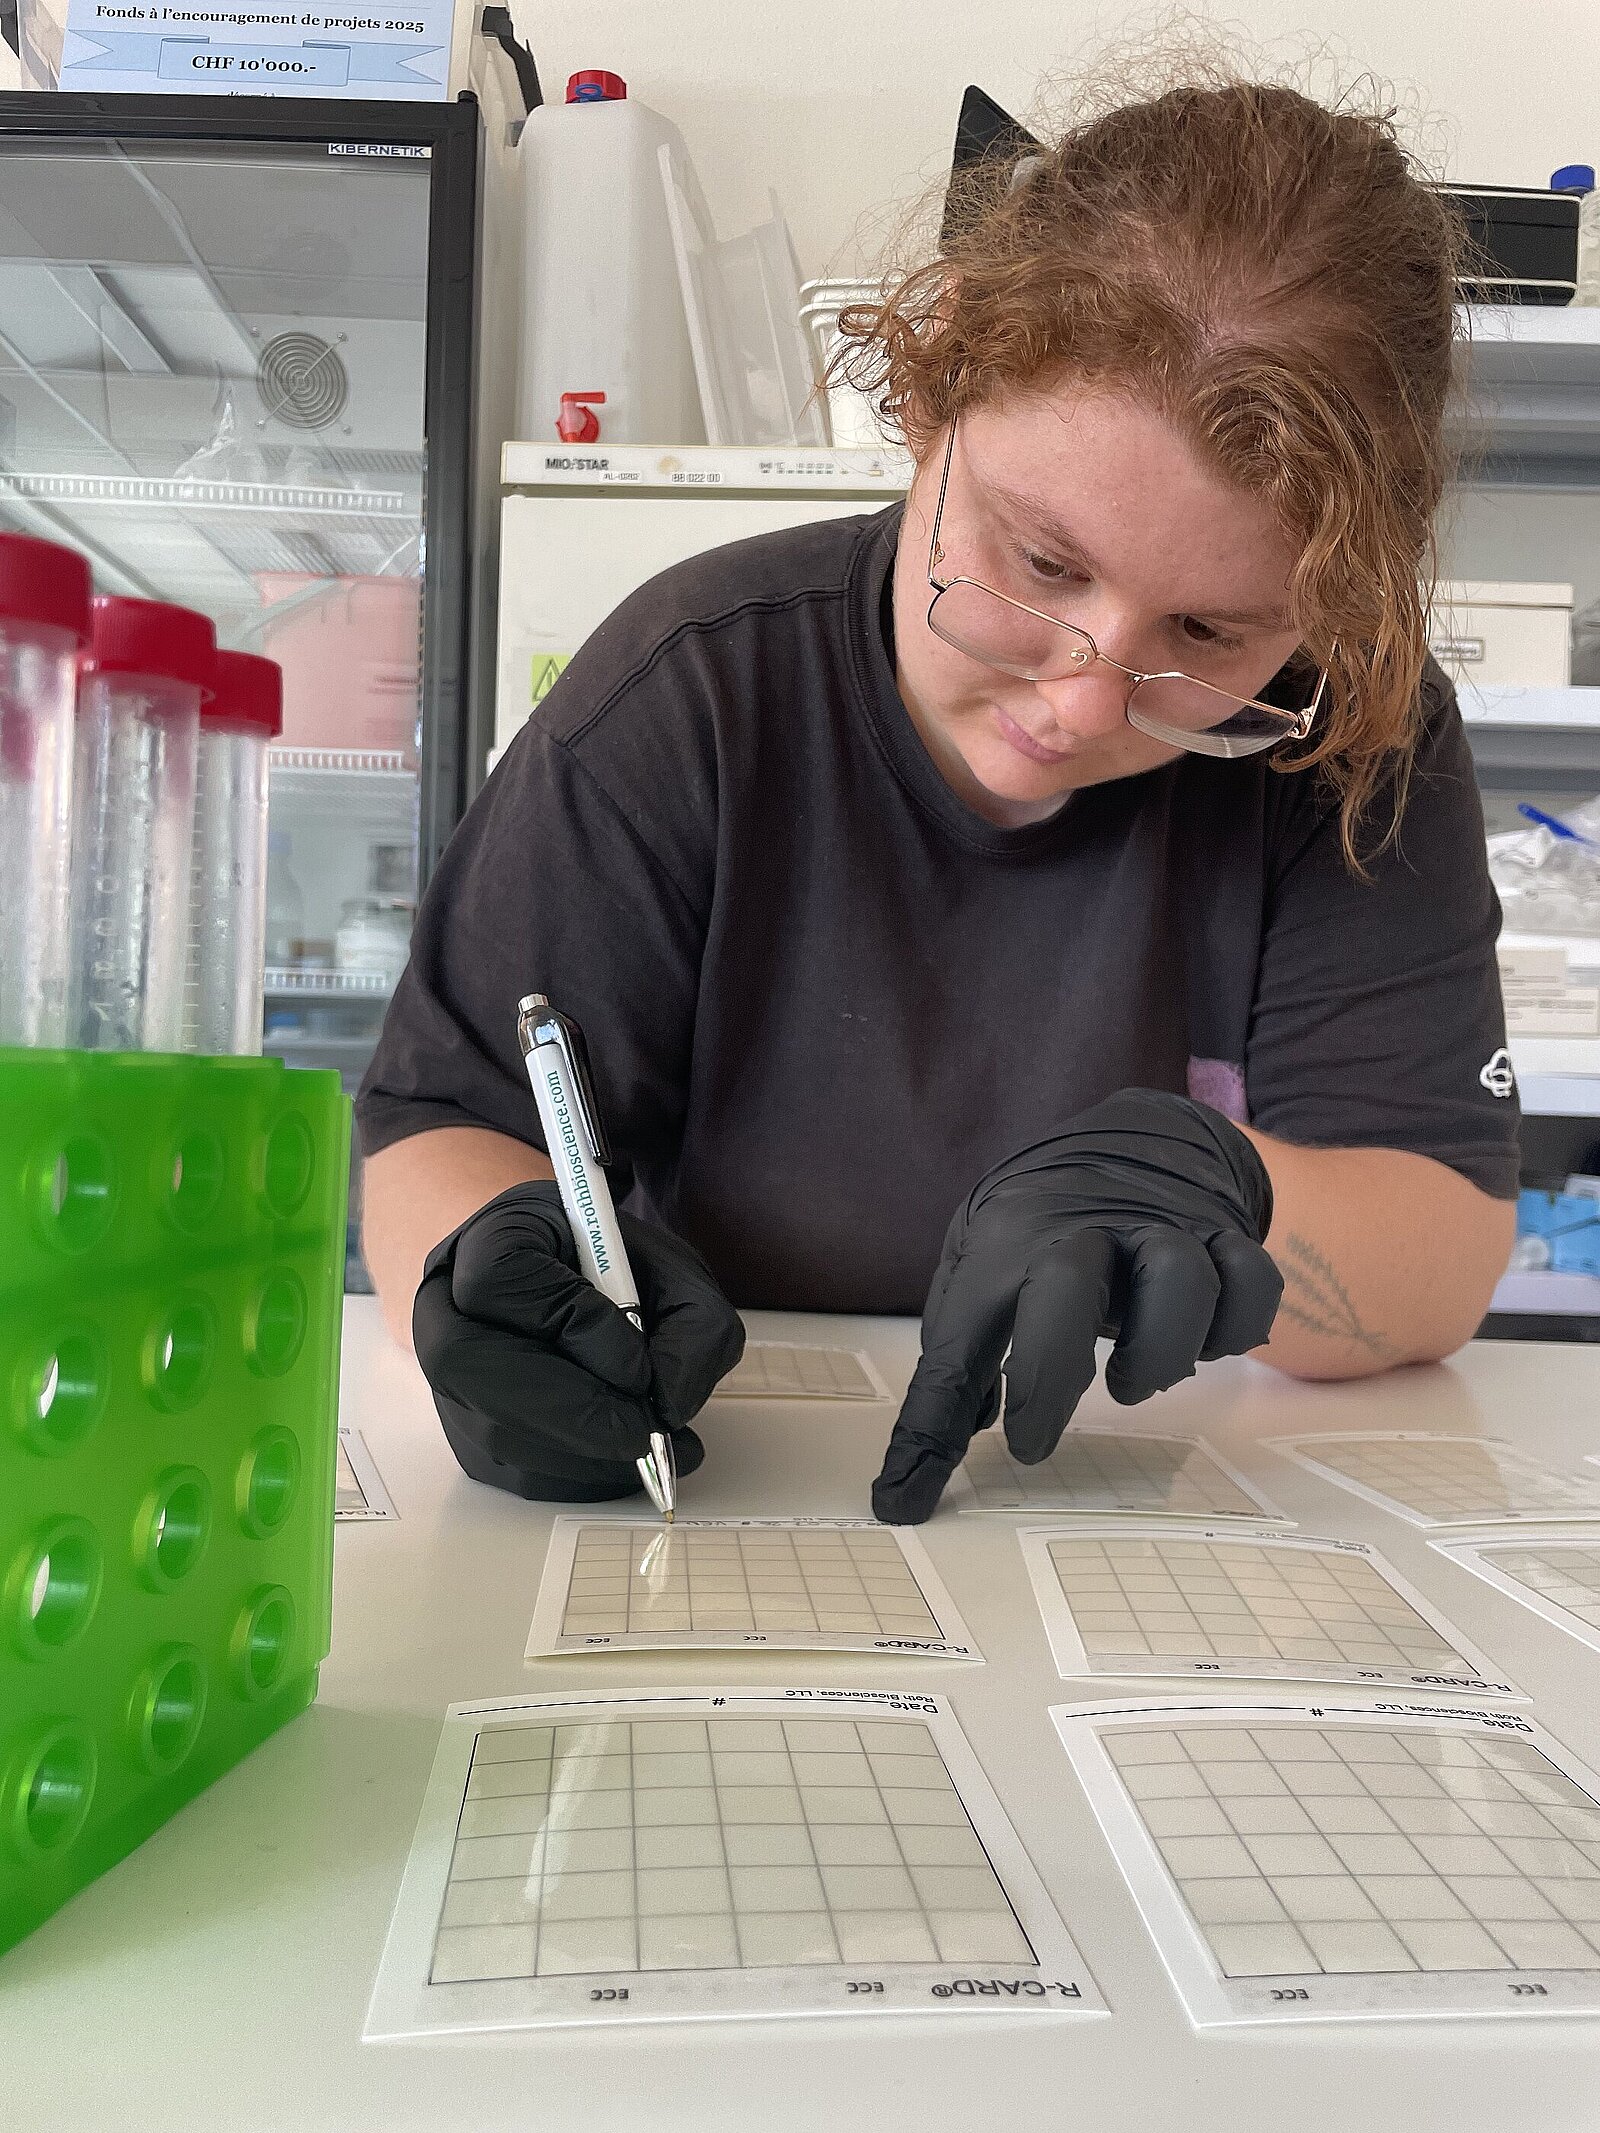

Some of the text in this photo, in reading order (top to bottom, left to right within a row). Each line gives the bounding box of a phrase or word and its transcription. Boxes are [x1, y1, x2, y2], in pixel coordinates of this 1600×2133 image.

[95, 5, 145, 19] Fonds
[149, 8, 159, 19] à
[301, 13, 321, 26] de
[324, 15, 381, 31] projets
[384, 20, 425, 34] 2025
[191, 55, 234, 70] CHF
[330, 144, 425, 157] KIBERNETIK
[546, 1069, 611, 1275] www.rothbioscience.com
[1357, 1671, 1384, 1679] ECC
[785, 1689, 813, 1697] LLC
[903, 1693, 935, 1704] Roth
[889, 1701, 939, 1714] Date
[1375, 1702, 1403, 1711] LLC
[1489, 1712, 1523, 1722] Roth
[1482, 1718, 1535, 1734] Date
[590, 1988, 629, 2000] ECC
[846, 1981, 884, 1994] ECC
[1270, 1988, 1309, 2000] ECC
[1507, 1983, 1548, 1996] ECC
